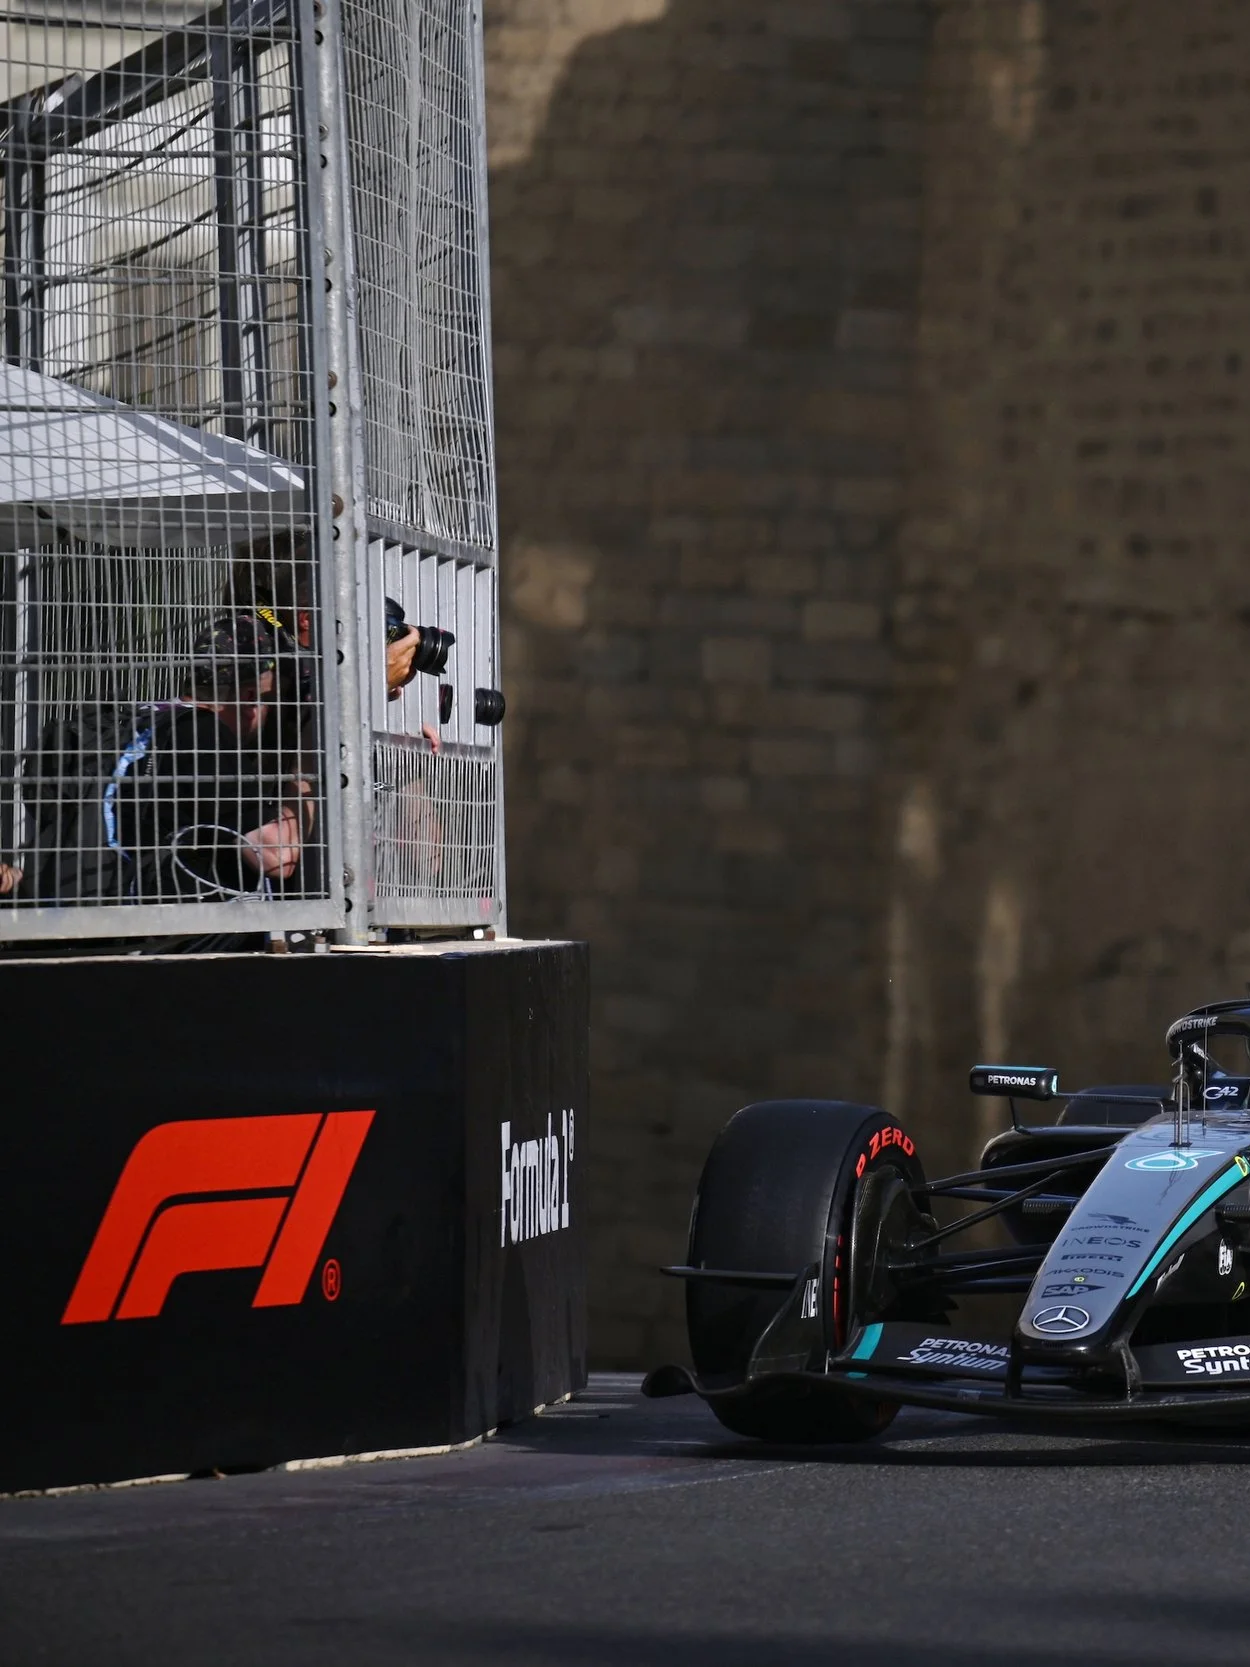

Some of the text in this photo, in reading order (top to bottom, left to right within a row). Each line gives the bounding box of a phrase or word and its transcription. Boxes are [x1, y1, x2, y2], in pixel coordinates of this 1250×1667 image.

[987, 1075, 1037, 1086] PETRONAS
[1202, 1086, 1239, 1100] G42
[869, 1127, 915, 1160] ZERO
[501, 1112, 559, 1248] Formula
[60, 1110, 376, 1325] F1
[1070, 1225, 1150, 1233] CROWDSTRIKE
[1061, 1237, 1142, 1249] INEOS
[1061, 1253, 1124, 1262] PIRELLI
[1045, 1268, 1125, 1278] AKKODIS
[1044, 1285, 1093, 1296] SAP
[920, 1338, 1011, 1358] PETRONA
[897, 1348, 1007, 1370] Syntium
